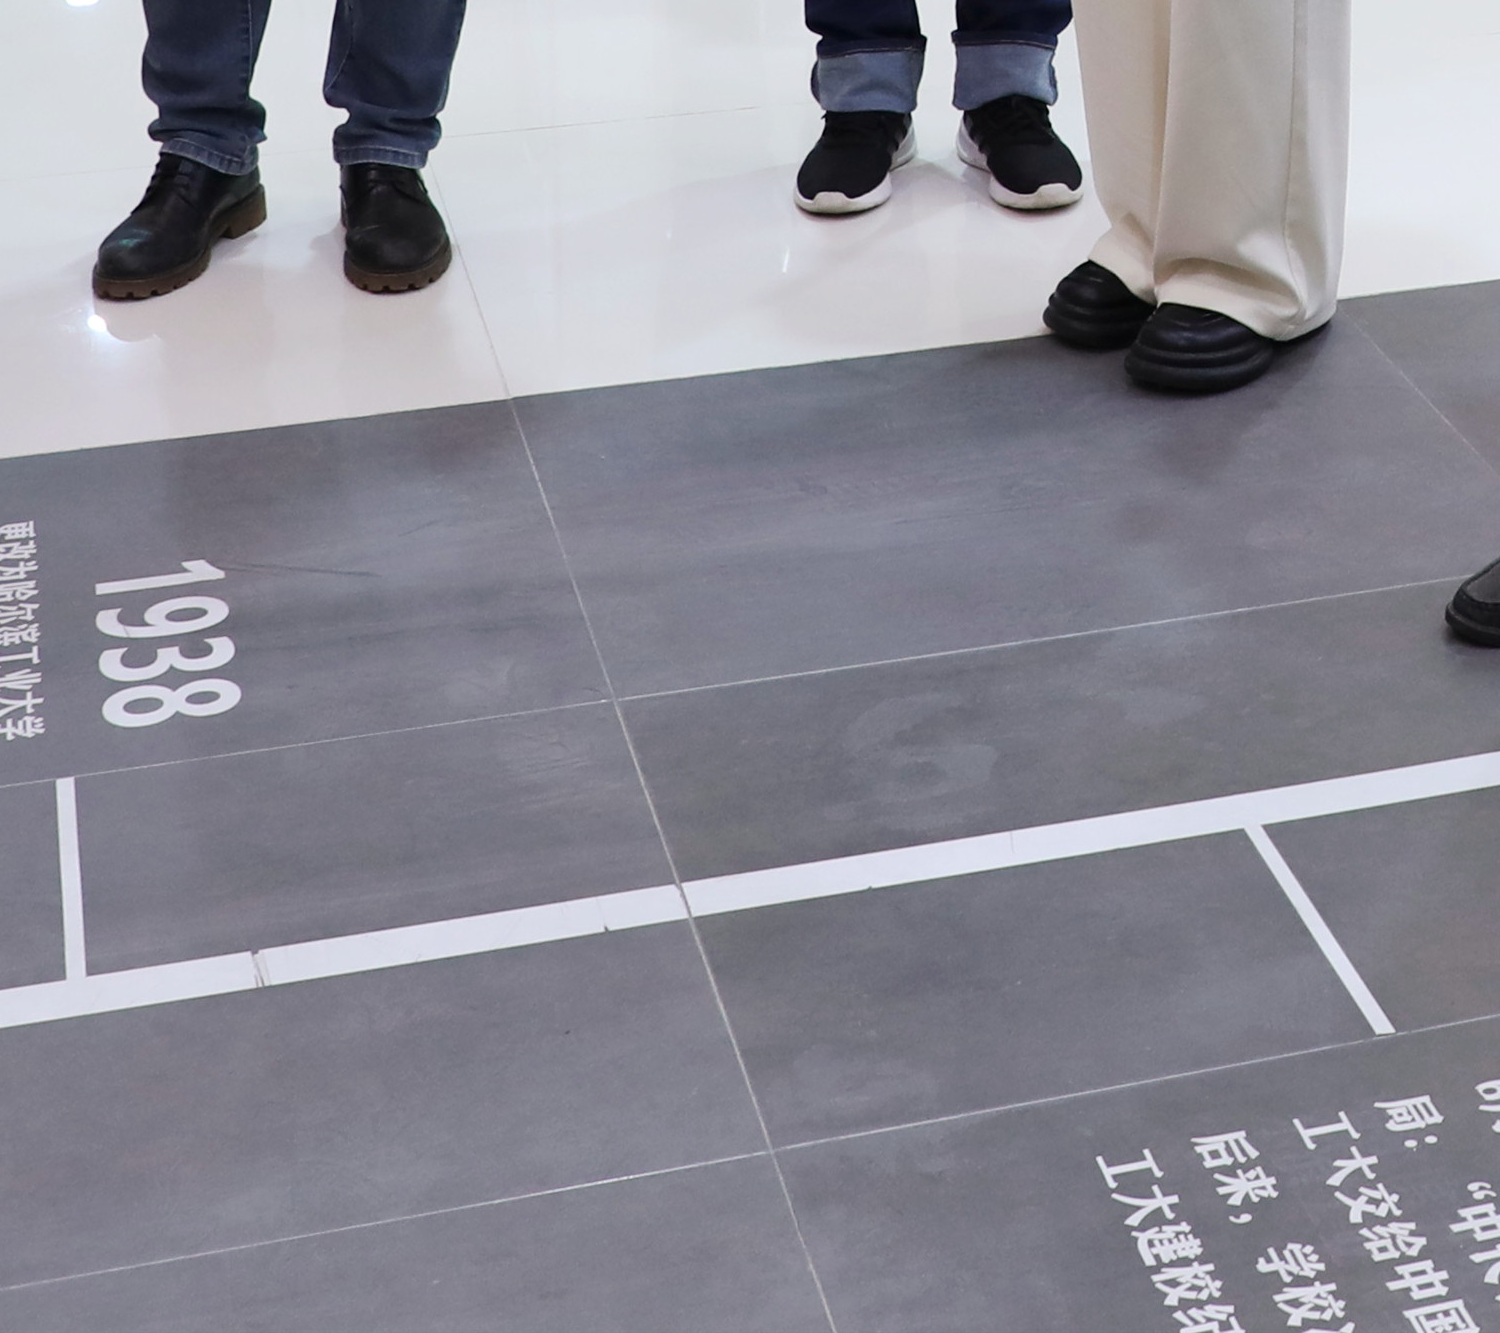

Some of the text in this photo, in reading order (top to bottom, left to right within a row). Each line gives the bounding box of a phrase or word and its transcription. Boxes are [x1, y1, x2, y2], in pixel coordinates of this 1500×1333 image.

[95, 559, 242, 729] 1938
[1191, 1130, 1356, 1333] 后来，学校
